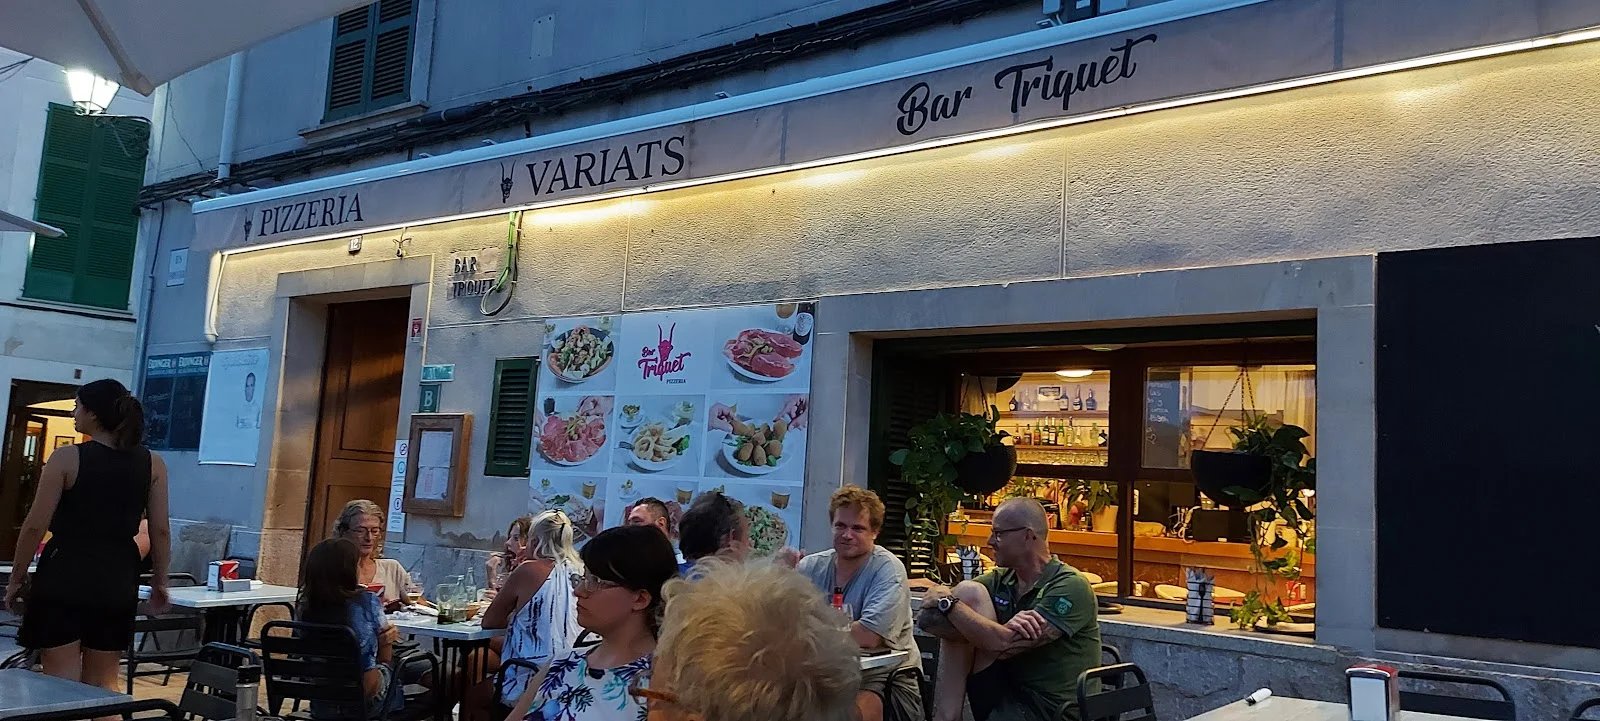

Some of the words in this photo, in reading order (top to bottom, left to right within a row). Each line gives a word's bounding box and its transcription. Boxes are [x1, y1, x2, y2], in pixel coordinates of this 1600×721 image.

[895, 81, 972, 136] Bar
[994, 33, 1158, 114] Triquet
[525, 135, 685, 196] VARIATS
[258, 192, 364, 237] PIZZERIA
[350, 238, 360, 249] 12
[454, 256, 477, 274] BAR
[641, 346, 656, 358] Bar
[637, 352, 692, 382] Triquet
[424, 390, 434, 407] B
